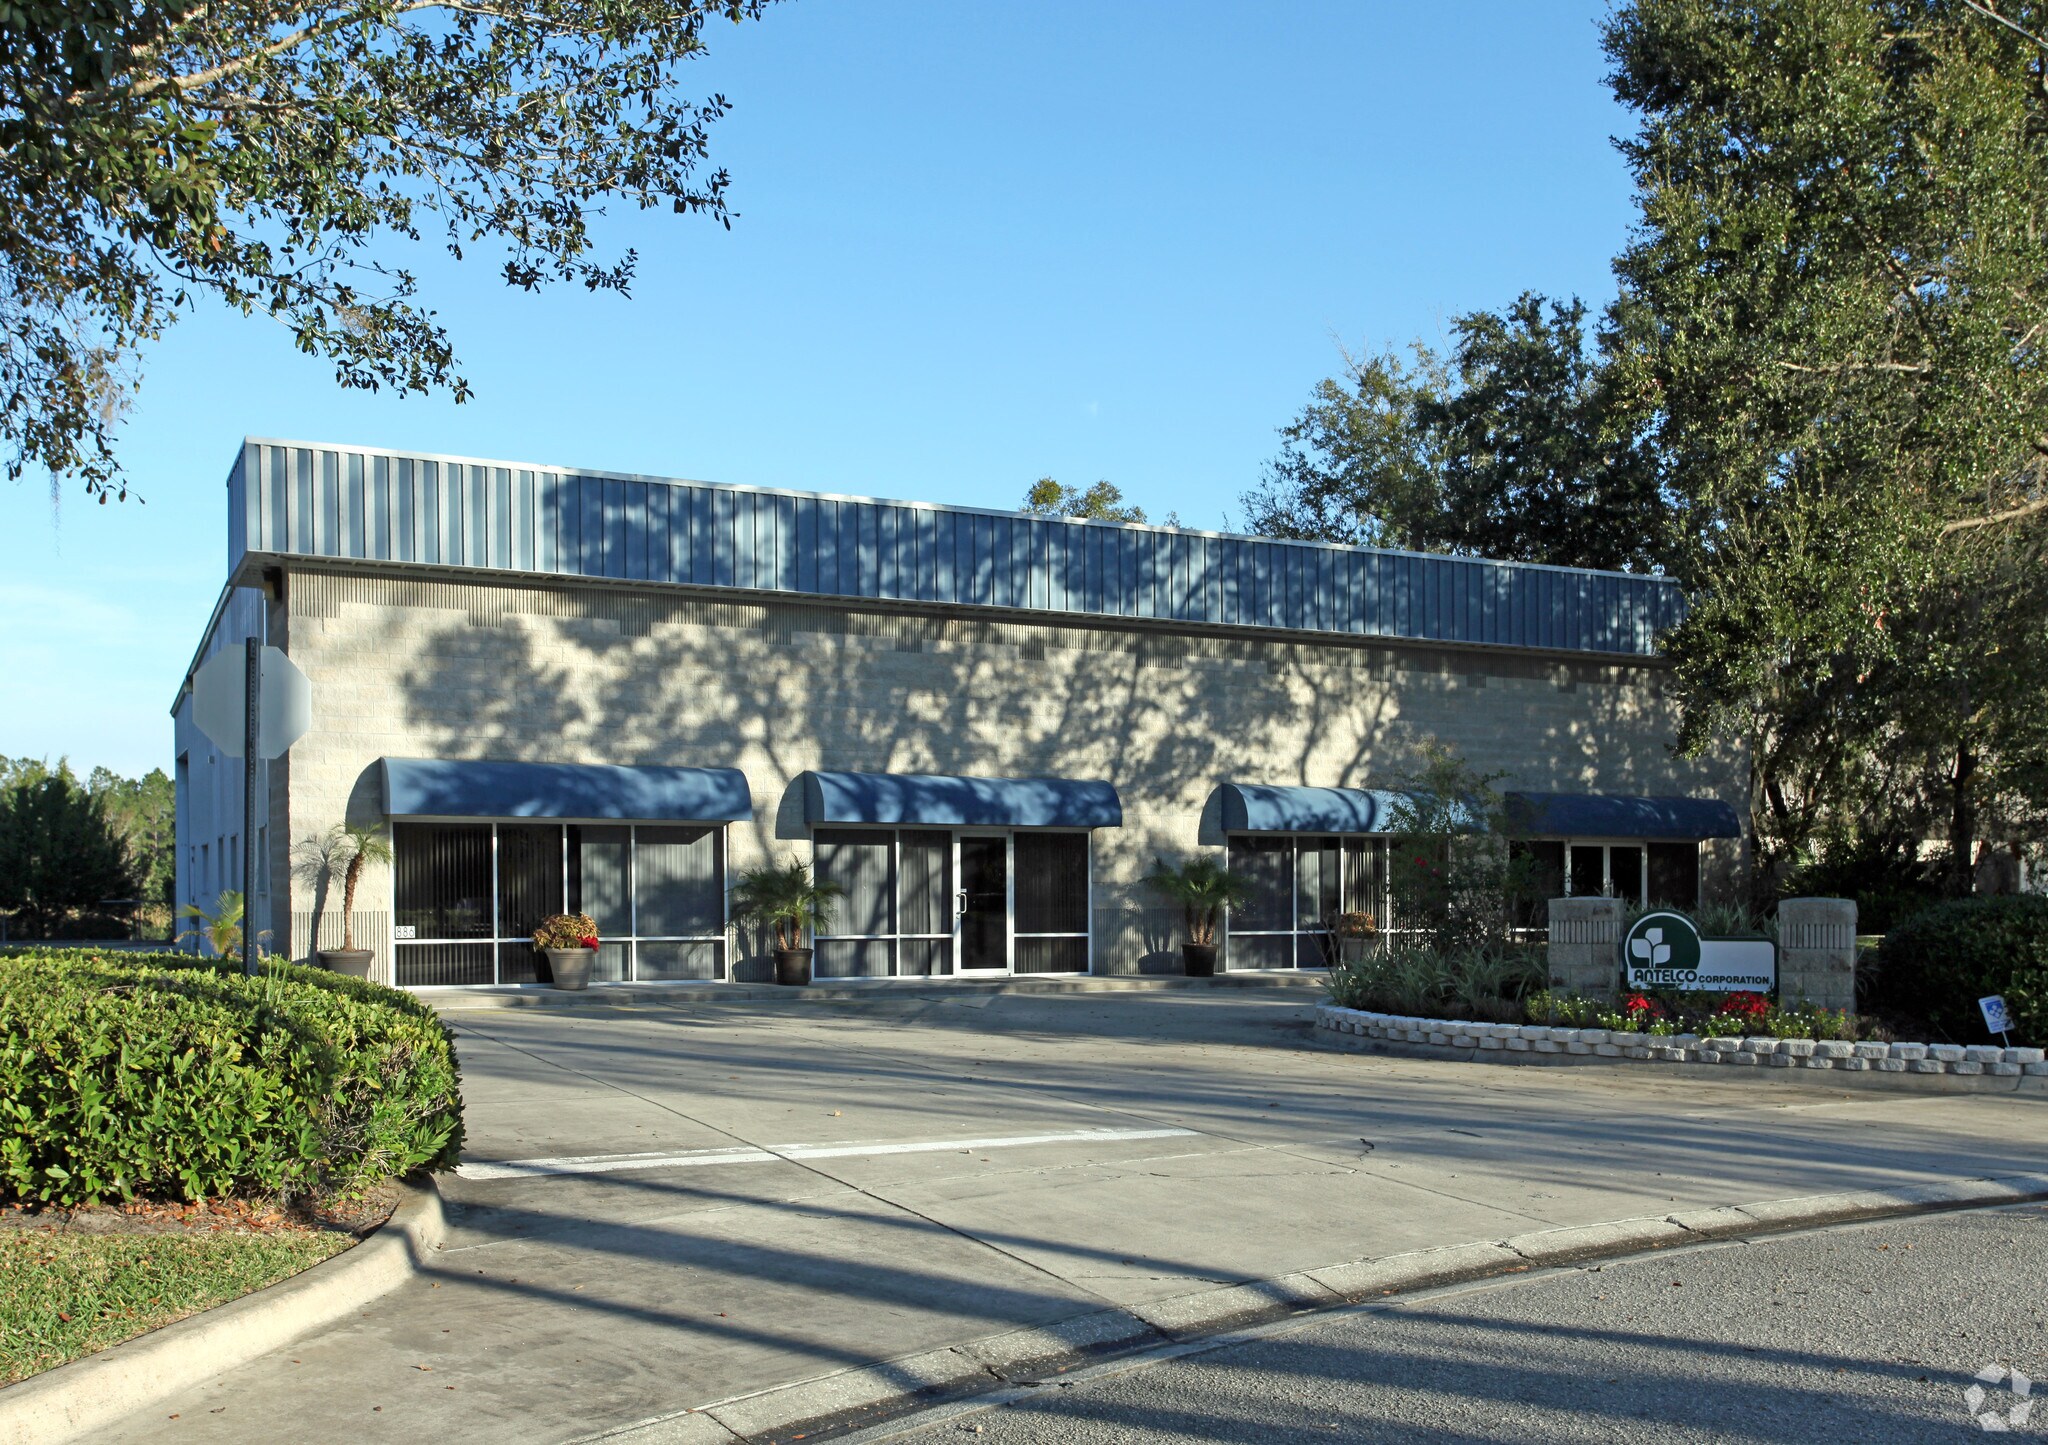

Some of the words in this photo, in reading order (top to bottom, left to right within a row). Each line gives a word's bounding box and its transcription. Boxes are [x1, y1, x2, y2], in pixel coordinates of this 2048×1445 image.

[396, 926, 415, 938] 886
[1634, 969, 1697, 983] ANTELCO
[1698, 975, 1769, 985] CORPORATION
